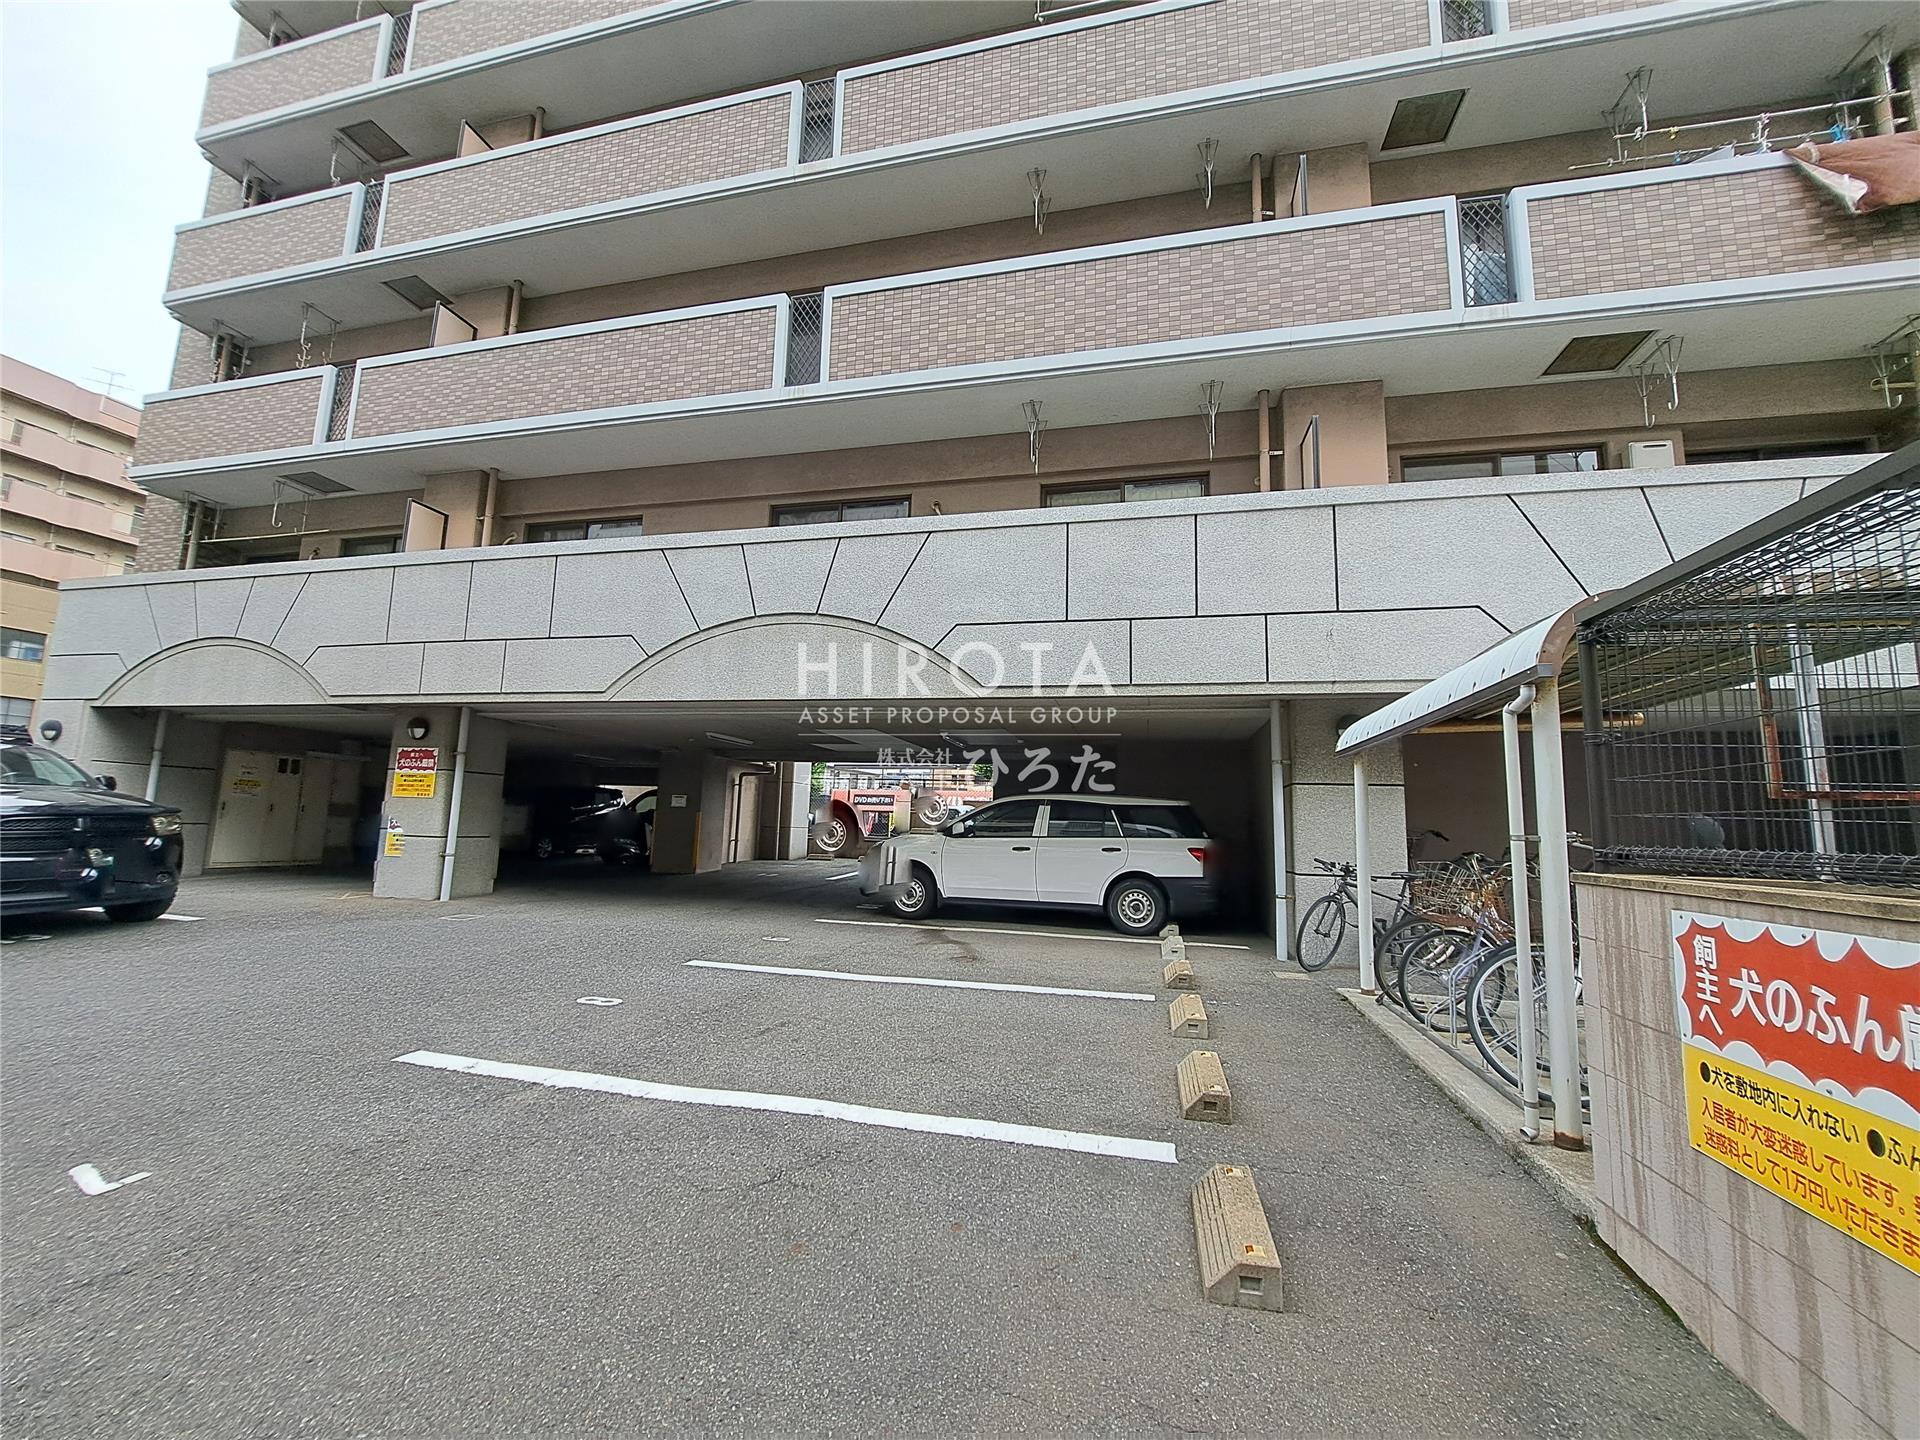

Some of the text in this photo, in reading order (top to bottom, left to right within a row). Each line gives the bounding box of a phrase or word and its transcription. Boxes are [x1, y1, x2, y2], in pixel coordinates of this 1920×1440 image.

[1692, 934, 1724, 1036] 飼主へ
[1701, 1097, 1920, 1224] 入居者が大変迷惑しています。
